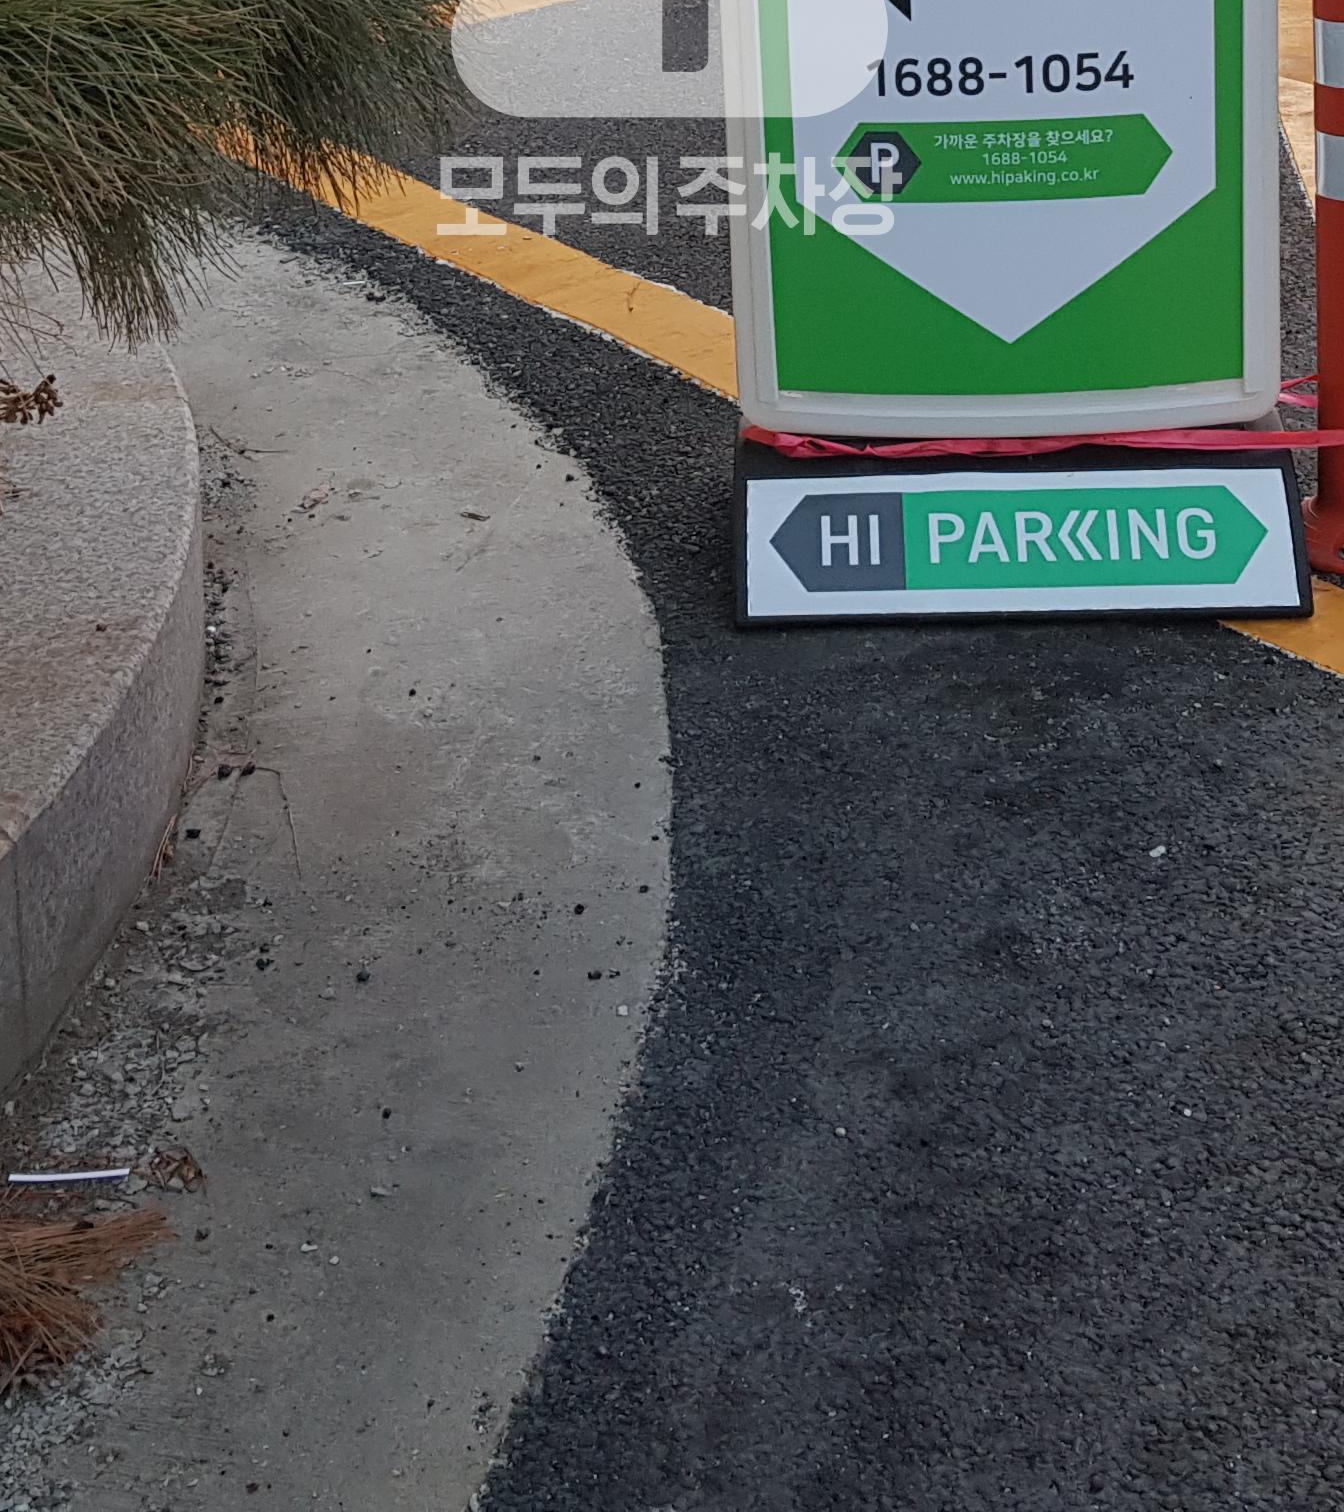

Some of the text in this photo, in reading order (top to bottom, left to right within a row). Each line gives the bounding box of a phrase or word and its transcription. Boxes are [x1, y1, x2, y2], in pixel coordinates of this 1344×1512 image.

[867, 51, 1136, 97] 1688-1054
[934, 128, 1114, 150] 가까운 주차장을 찾으세요?
[982, 150, 1069, 166] 1688-1054
[950, 167, 1100, 186] www.hipaking.co.kr
[820, 514, 882, 566] HI
